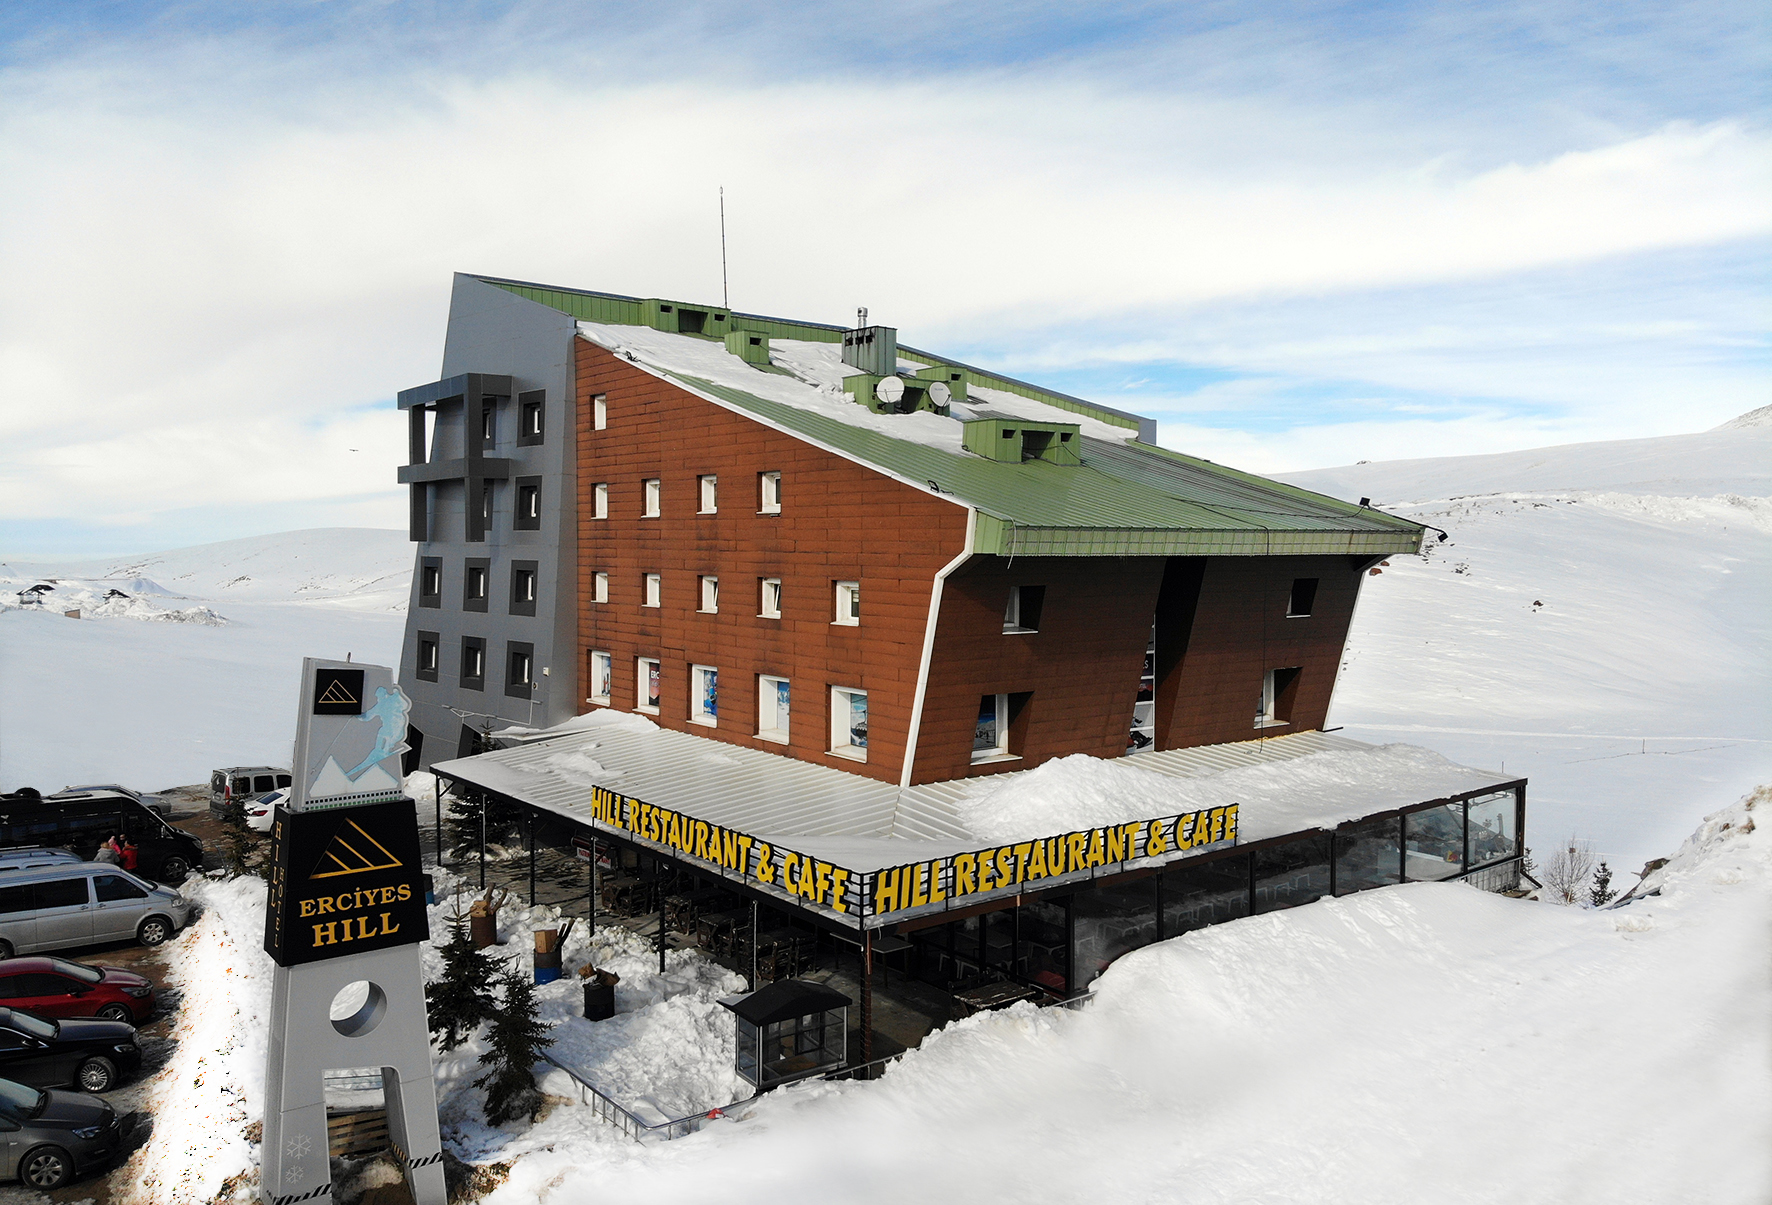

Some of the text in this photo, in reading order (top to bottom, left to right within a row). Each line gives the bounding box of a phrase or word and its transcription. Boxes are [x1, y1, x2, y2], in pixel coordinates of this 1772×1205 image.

[271, 820, 282, 908] HILL
[591, 786, 848, 913] HILL RESTAURANT & CAFE
[875, 805, 1239, 915] HILL RESTAURANT & CAFE
[274, 867, 285, 948] HOTEL
[312, 912, 400, 947] HILL
